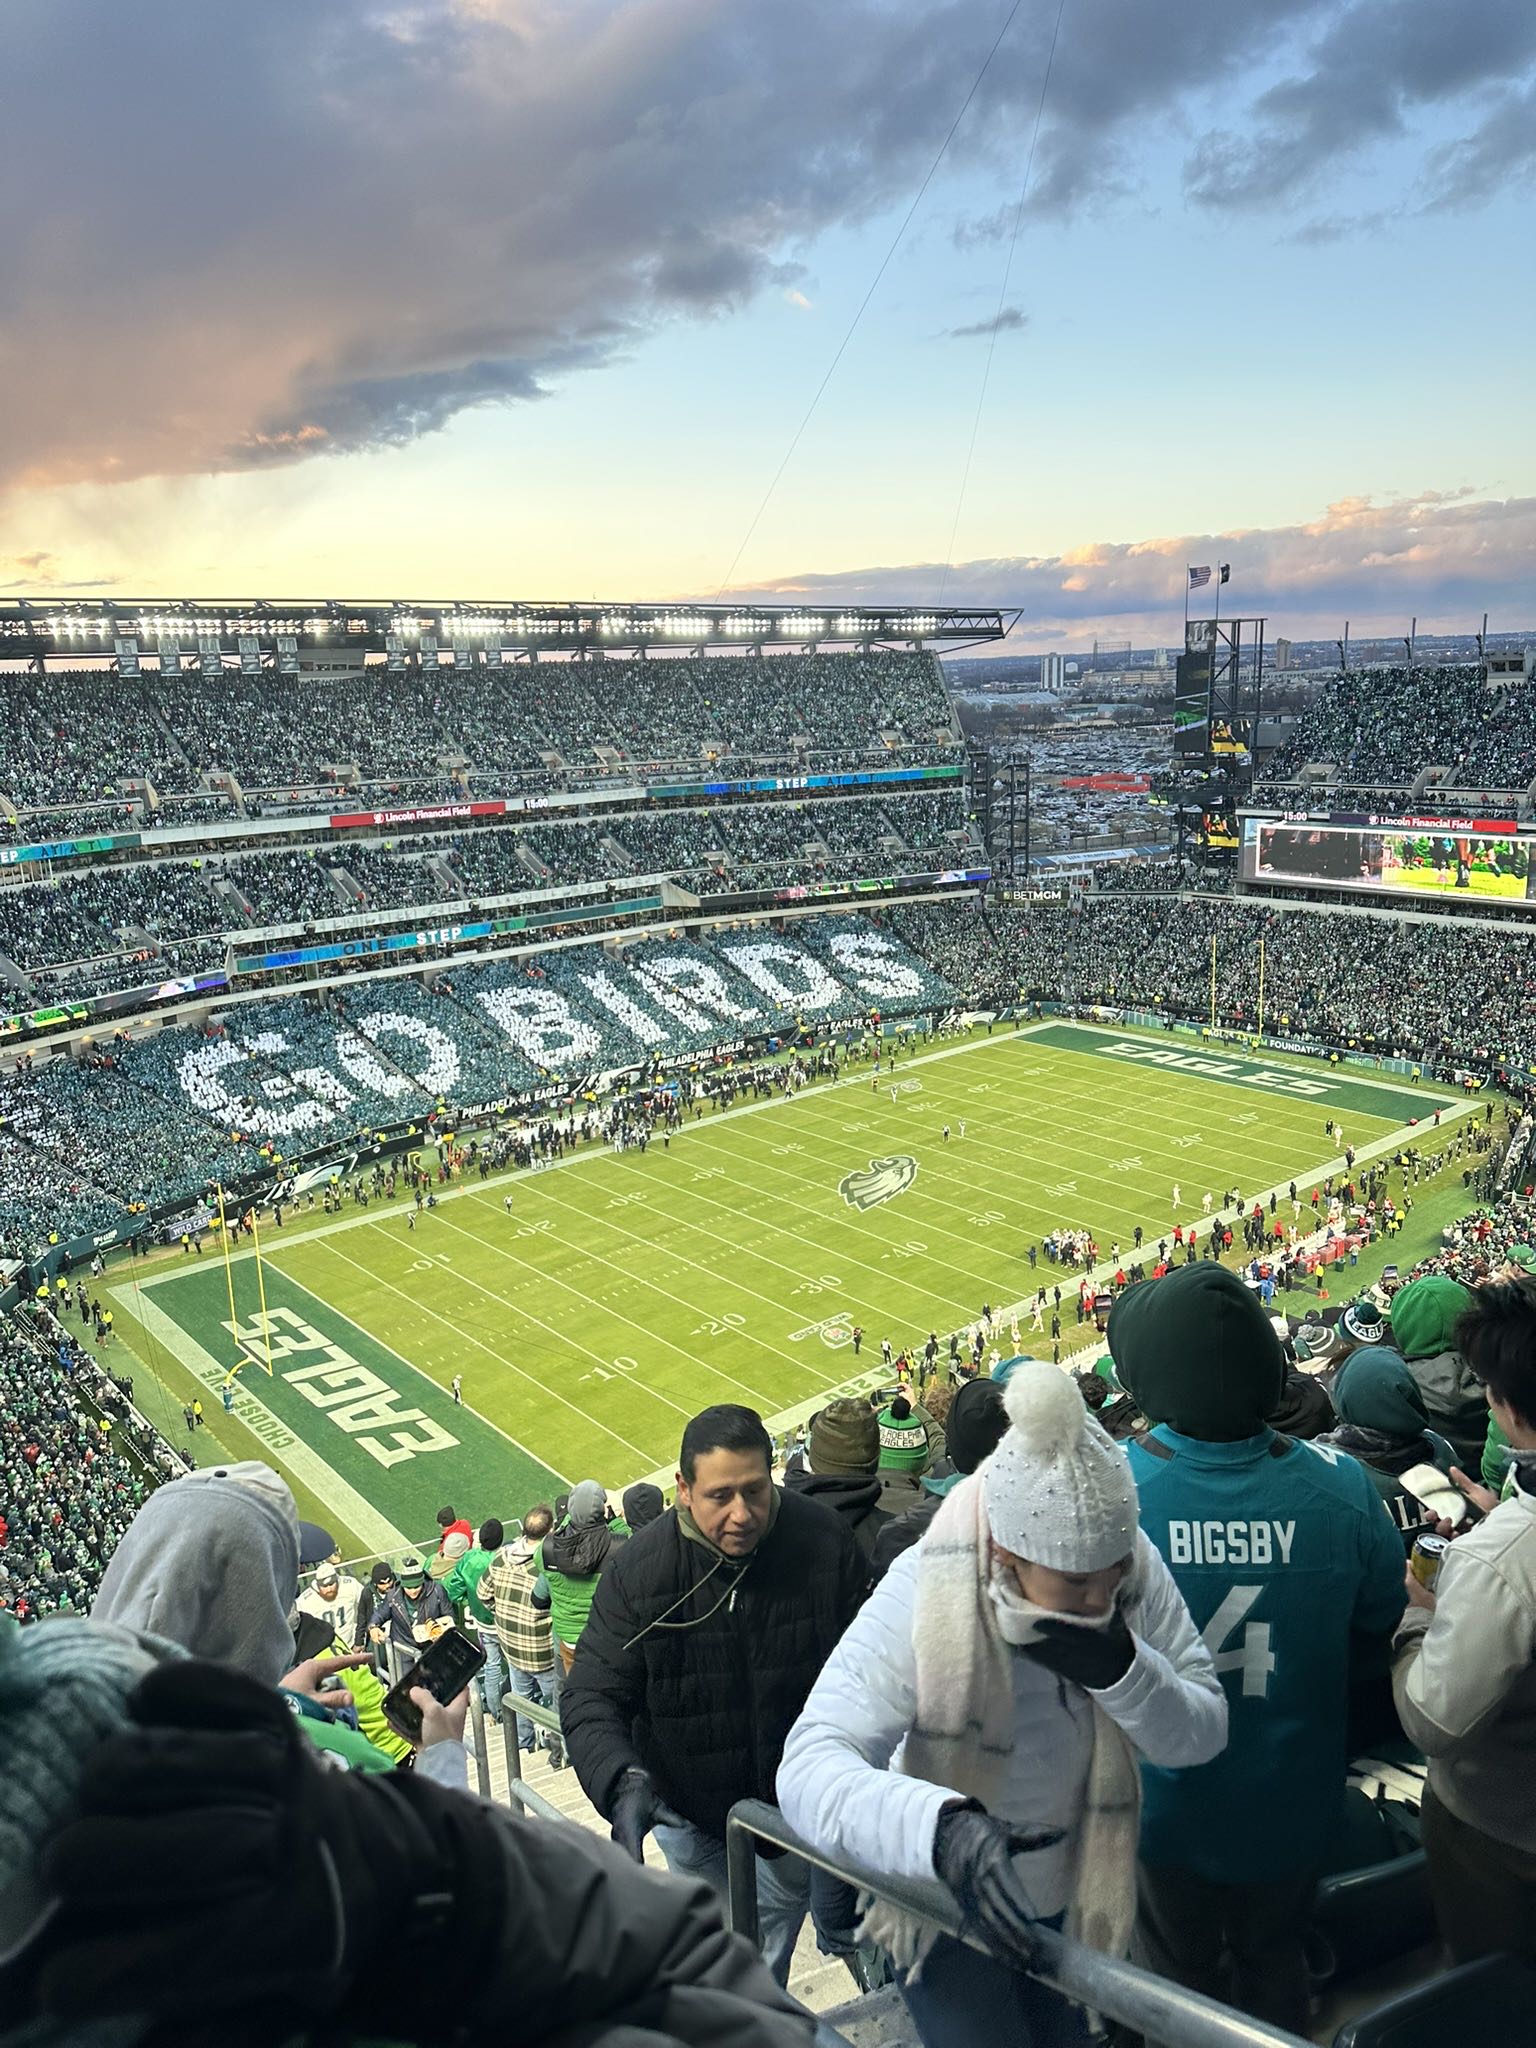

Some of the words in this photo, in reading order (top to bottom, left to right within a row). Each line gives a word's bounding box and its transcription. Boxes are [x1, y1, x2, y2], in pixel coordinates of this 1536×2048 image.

[776, 778, 808, 789] STEP
[525, 798, 548, 809] 15:00
[385, 811, 415, 822] Lincoln
[416, 808, 451, 820] Financial
[452, 805, 471, 817] Field
[1283, 811, 1307, 822] 15:00
[1380, 816, 1411, 826] Lincoln
[1412, 817, 1451, 829] Financial
[1452, 819, 1473, 830] Field
[1013, 890, 1062, 901] BETMGM
[344, 939, 388, 956] ONE
[416, 927, 462, 946] STEP
[830, 1018, 863, 1030] EAGLES
[176, 1011, 461, 1136] GO
[476, 932, 925, 1067] BIRDS
[658, 1048, 713, 1070] PHILADELPHIA
[716, 1041, 745, 1056] EAGLES
[1096, 1042, 1342, 1095] EAGLES
[462, 1094, 530, 1119] PHILADELPIA
[535, 1083, 569, 1101] EAGLES
[1171, 1133, 1197, 1148] 20
[1109, 1156, 1135, 1172] 30
[611, 1191, 647, 1207] 30
[1045, 1183, 1073, 1199] 40
[173, 1223, 191, 1237] WILD
[194, 1216, 213, 1230] CARD
[518, 1219, 557, 1237] 20
[968, 1210, 1006, 1227] 50
[891, 1241, 928, 1259] 40
[412, 1252, 452, 1272] 10
[801, 1274, 842, 1295] 30
[701, 1312, 747, 1336] 20
[592, 1356, 638, 1382] 10
[200, 1368, 244, 1397] LVE
[220, 1307, 461, 1469] EAGLES
[232, 1398, 295, 1449] CHOOSE
[880, 1437, 914, 1447] EAGLES
[1168, 1520, 1296, 1564] BIGSBY
[1201, 1585, 1275, 1697] 4
